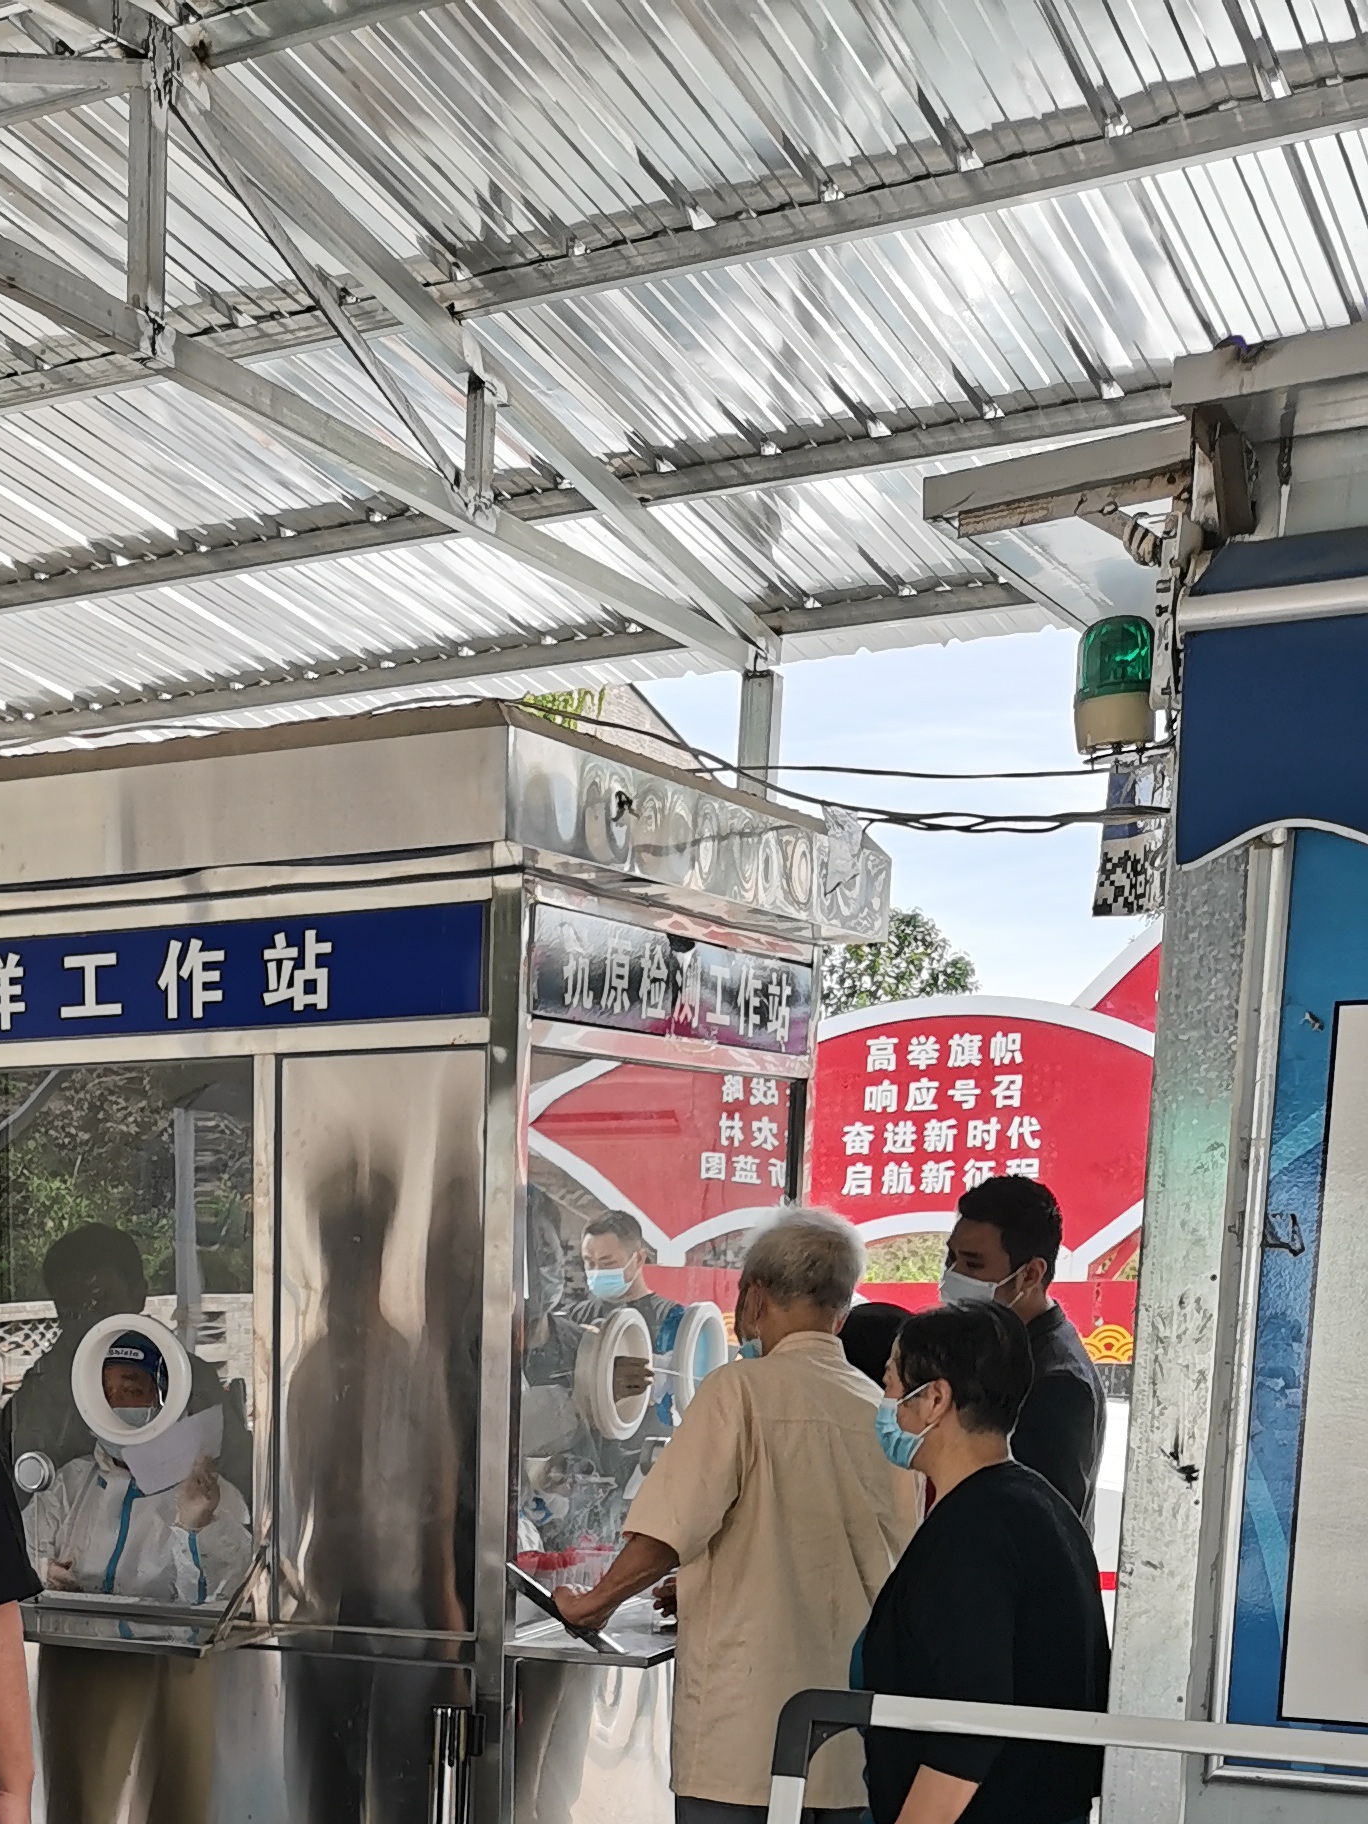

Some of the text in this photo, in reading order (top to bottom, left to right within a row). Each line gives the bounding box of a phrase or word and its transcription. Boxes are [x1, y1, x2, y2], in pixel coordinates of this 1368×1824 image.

[865, 1030, 1024, 1073] 高举旗帜
[863, 1073, 1024, 1114] 响应号召
[841, 1115, 1042, 1156] 奋进新时代
